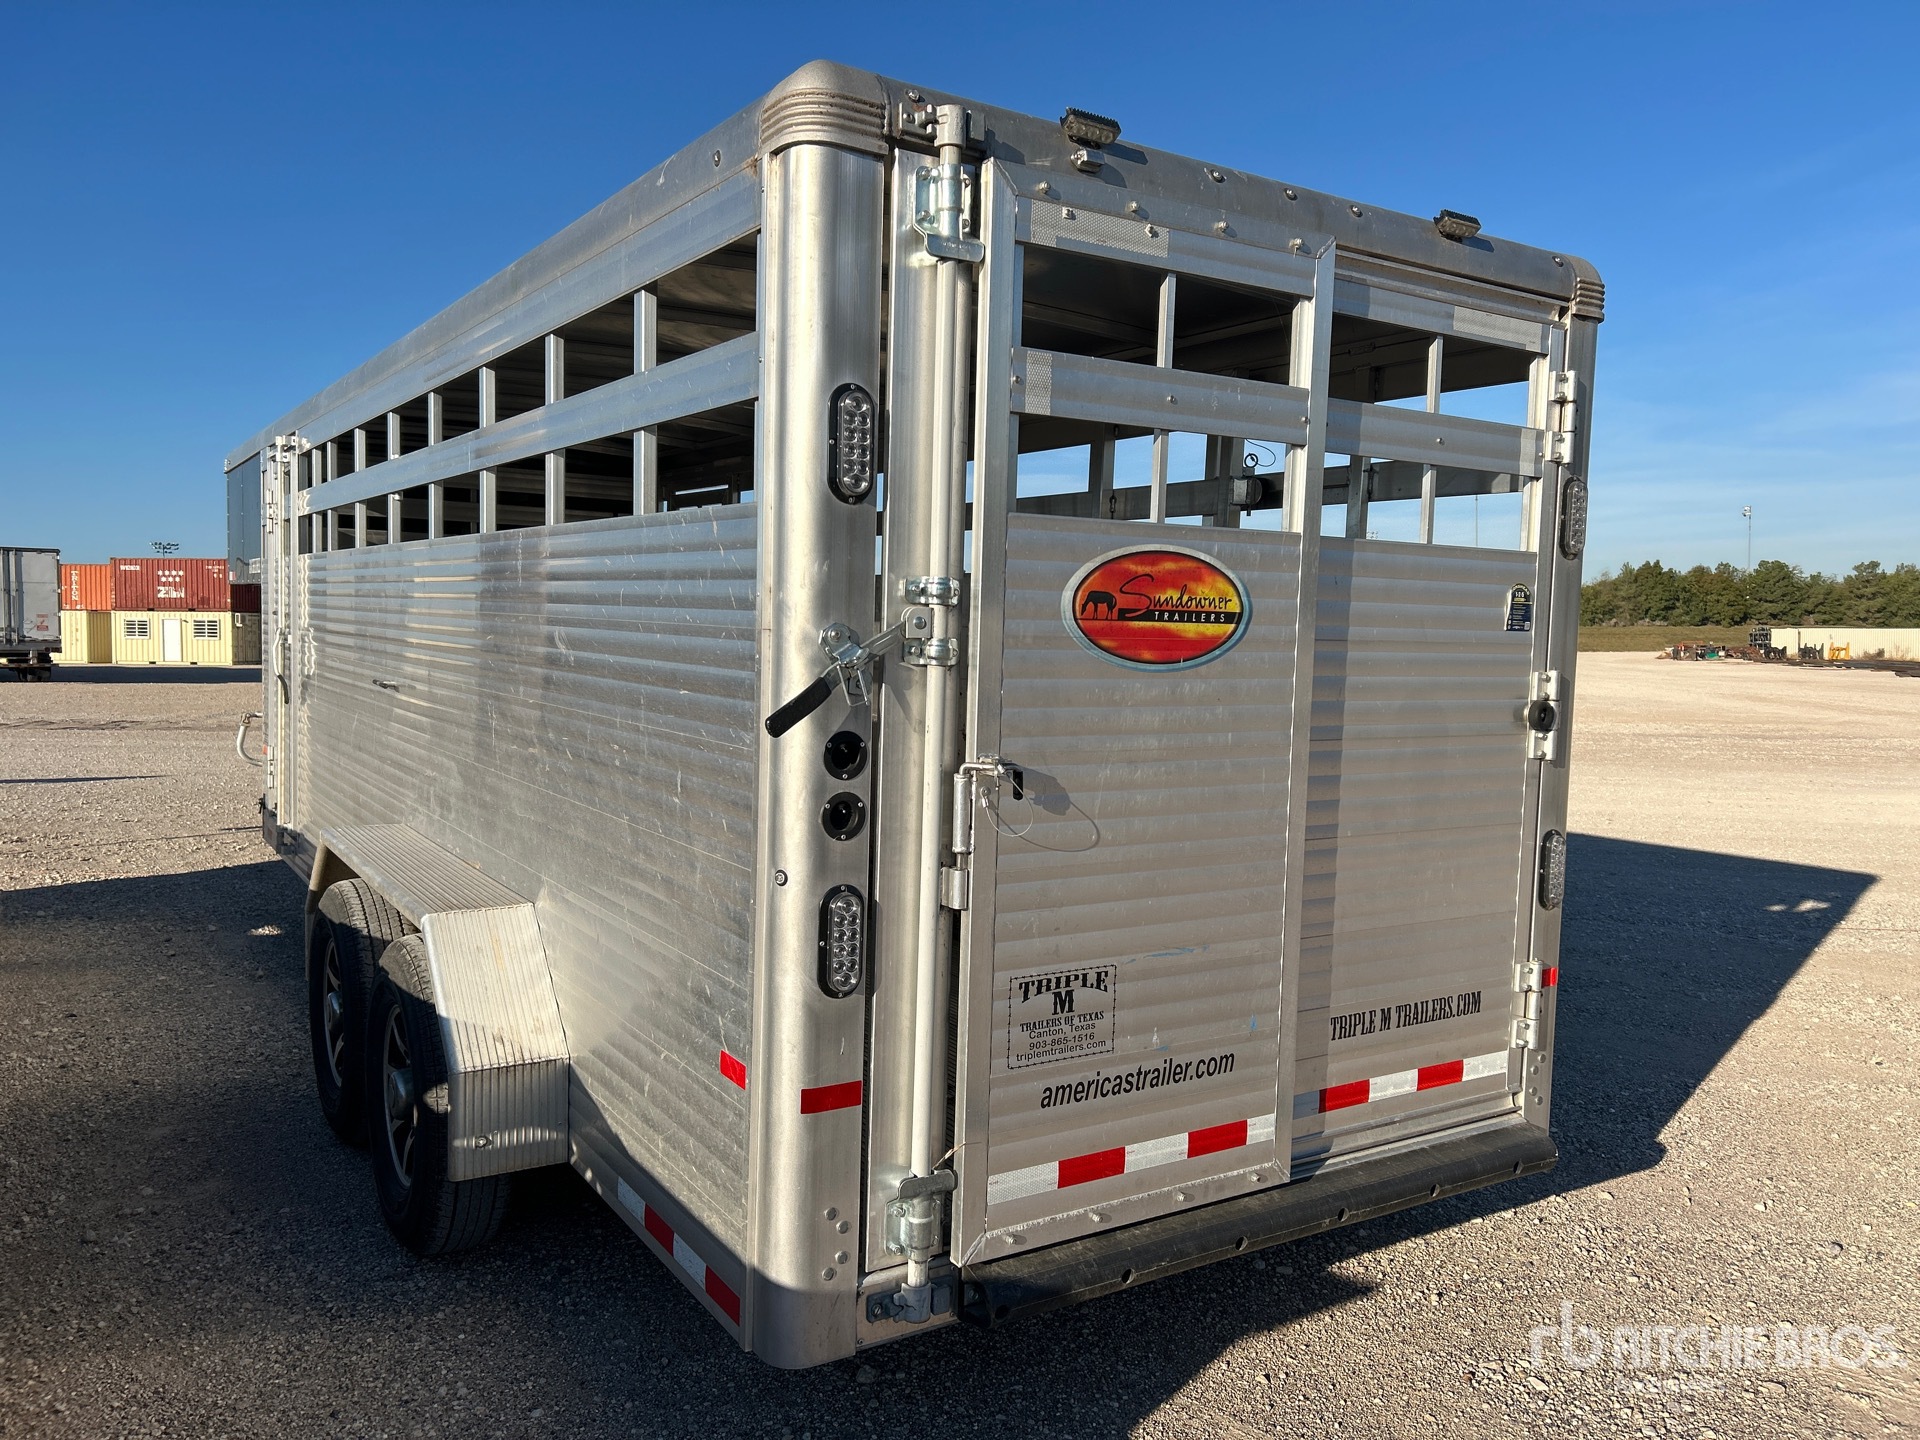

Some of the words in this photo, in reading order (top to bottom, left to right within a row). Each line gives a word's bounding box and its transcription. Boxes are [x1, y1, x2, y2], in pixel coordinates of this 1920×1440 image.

[71, 570, 79, 601] TRITON
[1119, 573, 1232, 618] Sundowner
[1154, 611, 1226, 623] TRAILERS
[1018, 970, 1109, 1003] TRIPLE
[1052, 989, 1075, 1016] M
[1330, 1009, 1377, 1041] TRIPLE
[1379, 1006, 1392, 1032] M
[1395, 990, 1482, 1029] TRAILERS.COM
[1019, 1016, 1063, 1033] TRAILERS
[1064, 1014, 1075, 1026] OF
[1077, 1010, 1105, 1024] TEXAS
[1029, 1028, 1067, 1040] Canton,
[1069, 1022, 1096, 1033] Texas
[1016, 1039, 1106, 1063] triplemtrailers.com
[1029, 1031, 1095, 1051] 903-865-1516
[1040, 1052, 1235, 1110] americastrailer.com
